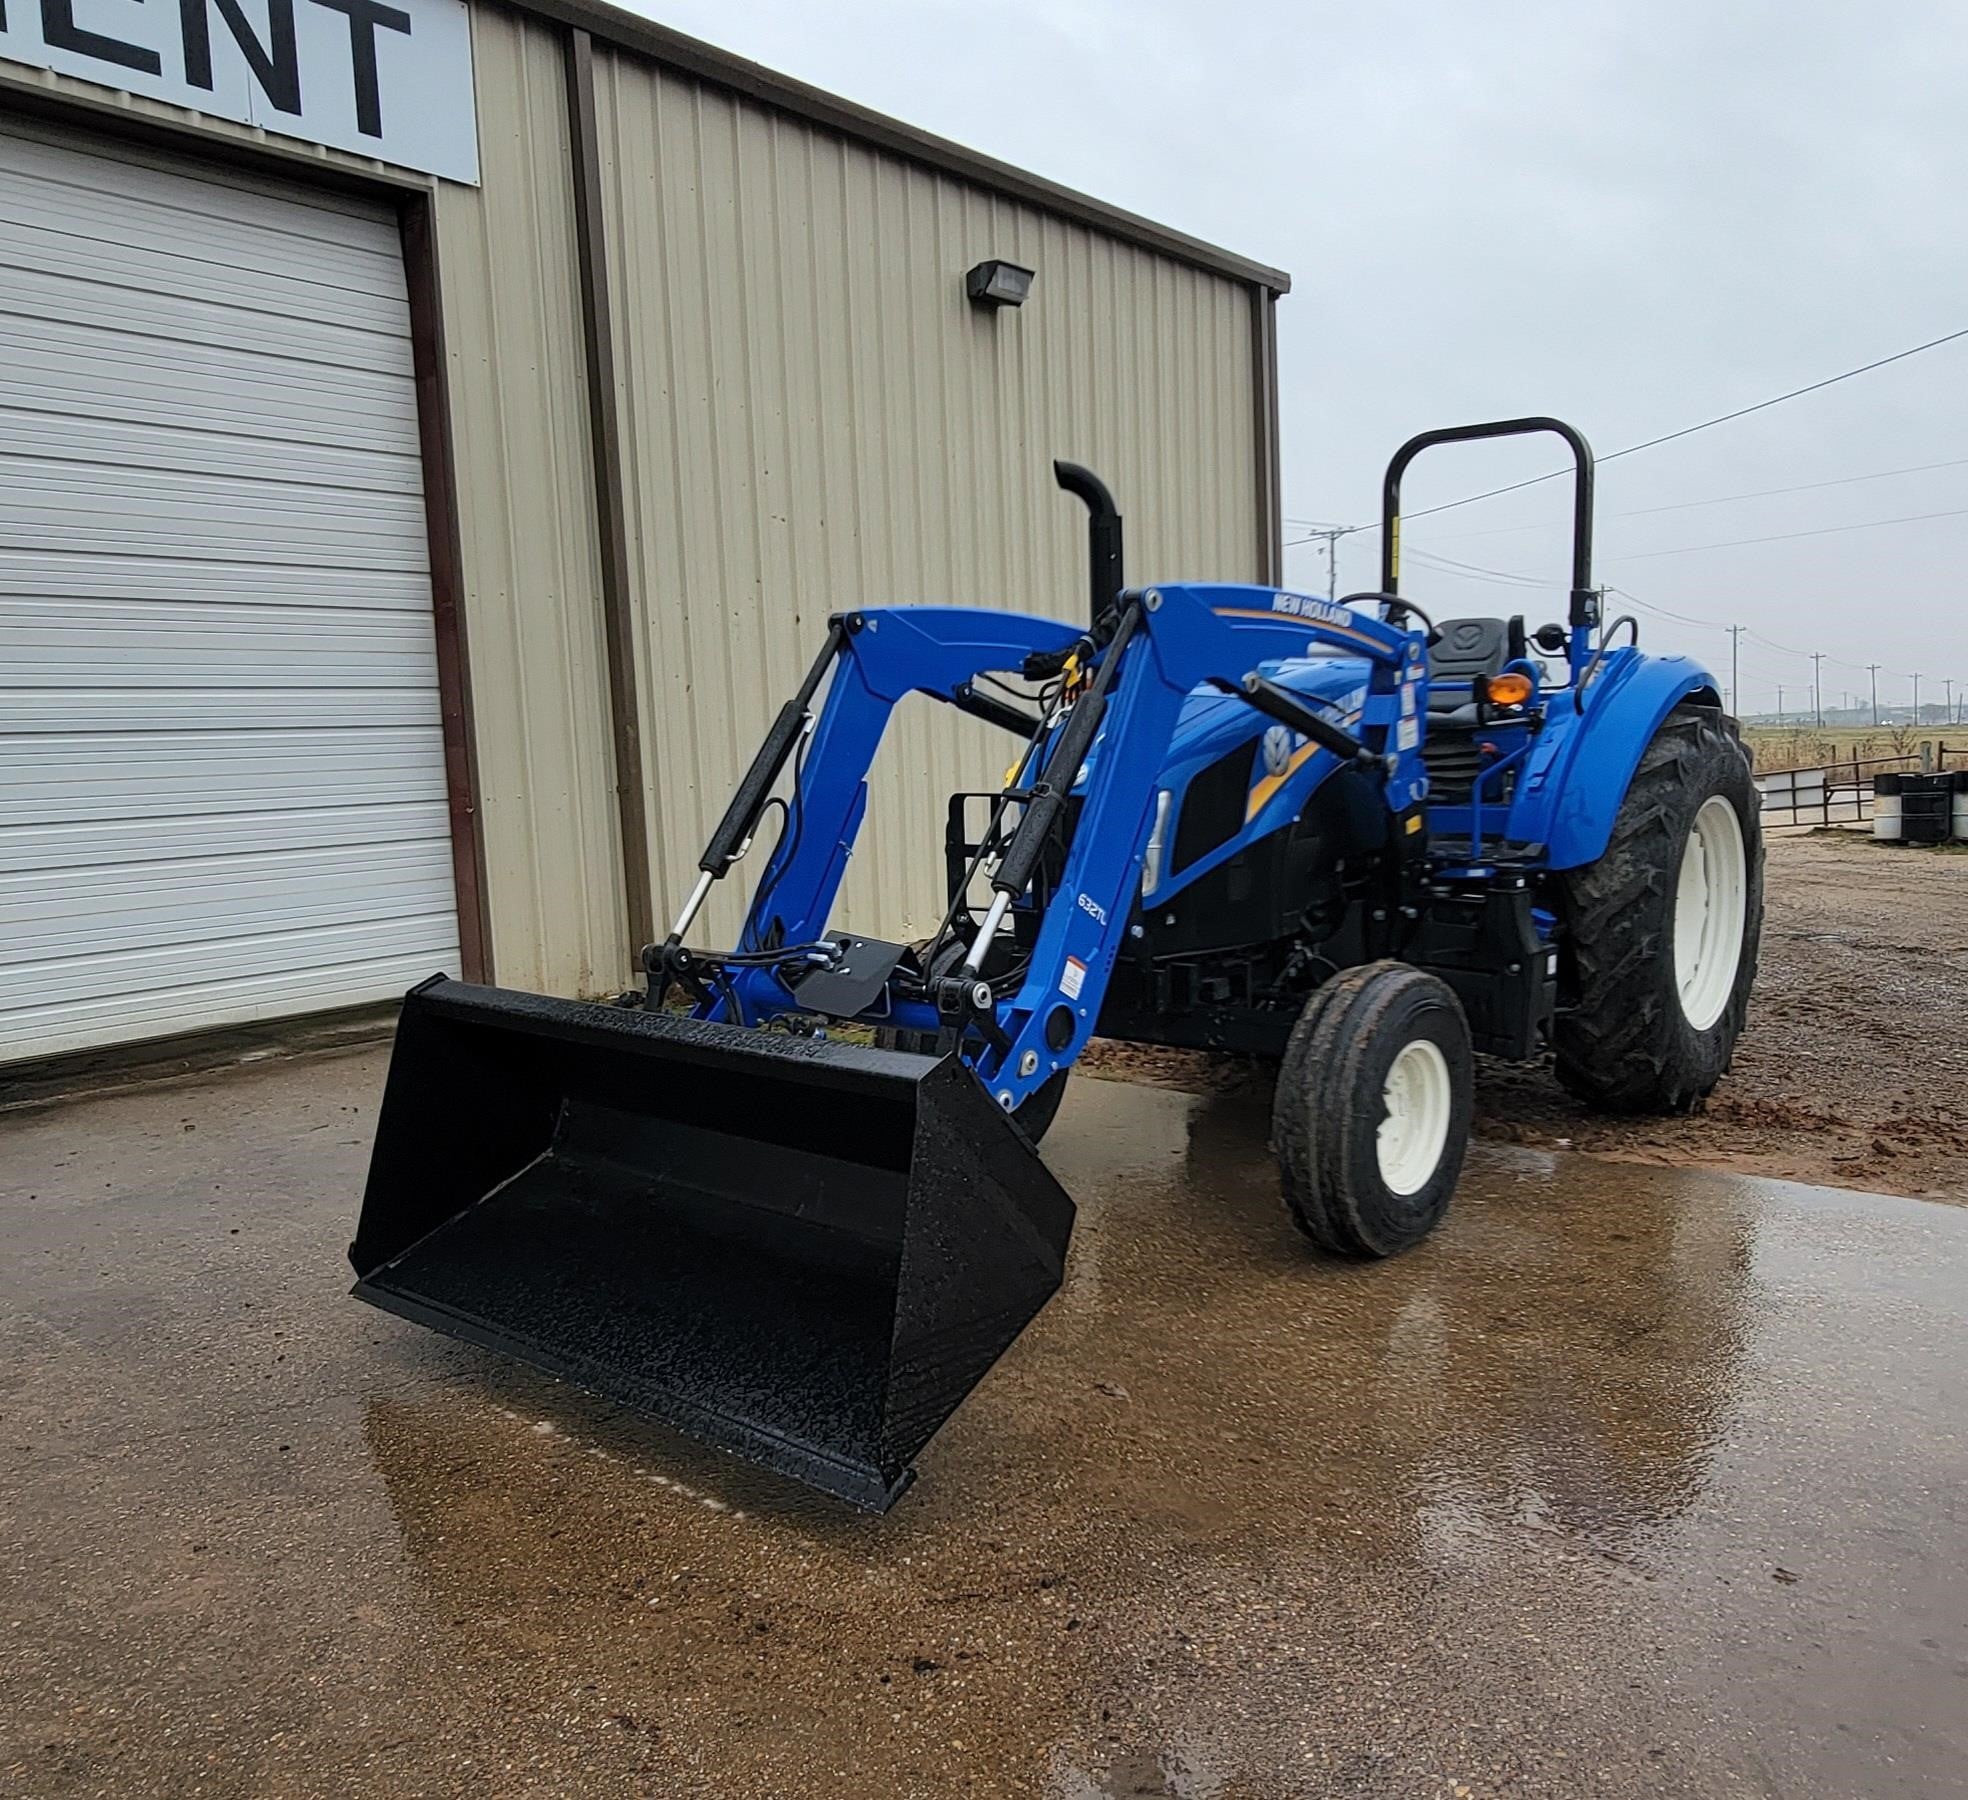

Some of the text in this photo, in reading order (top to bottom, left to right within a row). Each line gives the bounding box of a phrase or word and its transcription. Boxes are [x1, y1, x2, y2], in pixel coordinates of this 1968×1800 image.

[0, 0, 412, 139] NT
[1272, 593, 1353, 628] NEW HOLLAND
[1078, 893, 1107, 926] 632TL
